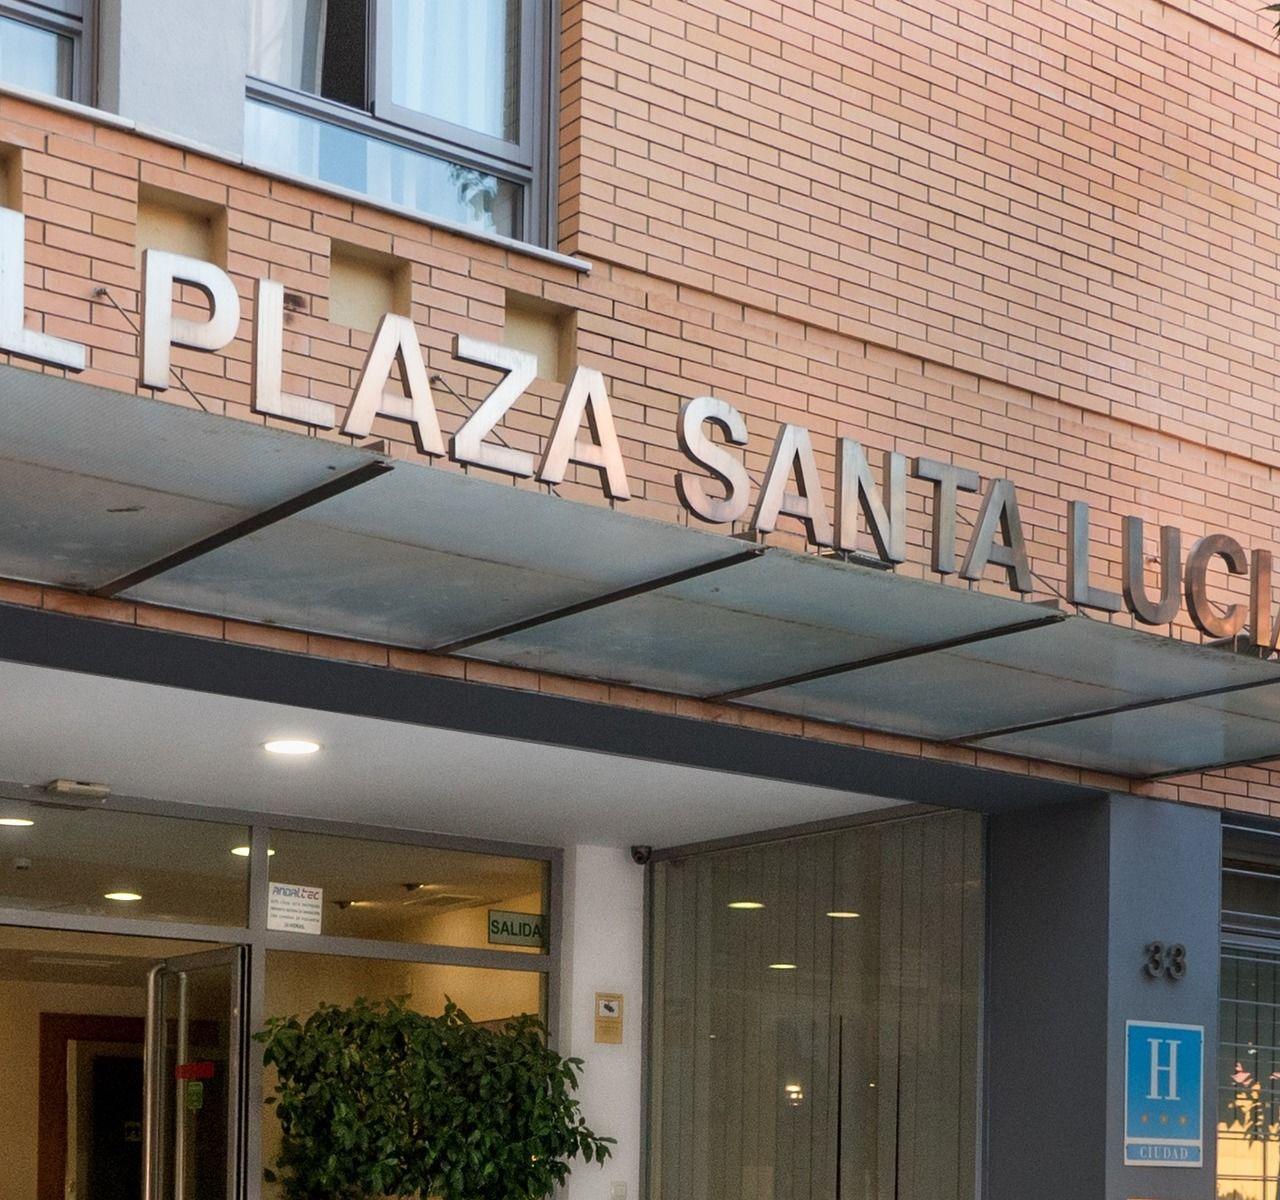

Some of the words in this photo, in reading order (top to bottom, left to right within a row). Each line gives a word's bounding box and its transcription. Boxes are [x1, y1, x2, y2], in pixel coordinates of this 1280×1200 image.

[138, 247, 632, 502] PLAZA
[675, 397, 1033, 594] SANTA
[491, 919, 542, 938] SALIDA
[1143, 940, 1186, 980] 33
[1146, 1038, 1181, 1101] H
[1140, 1145, 1188, 1160] CIUDAD
